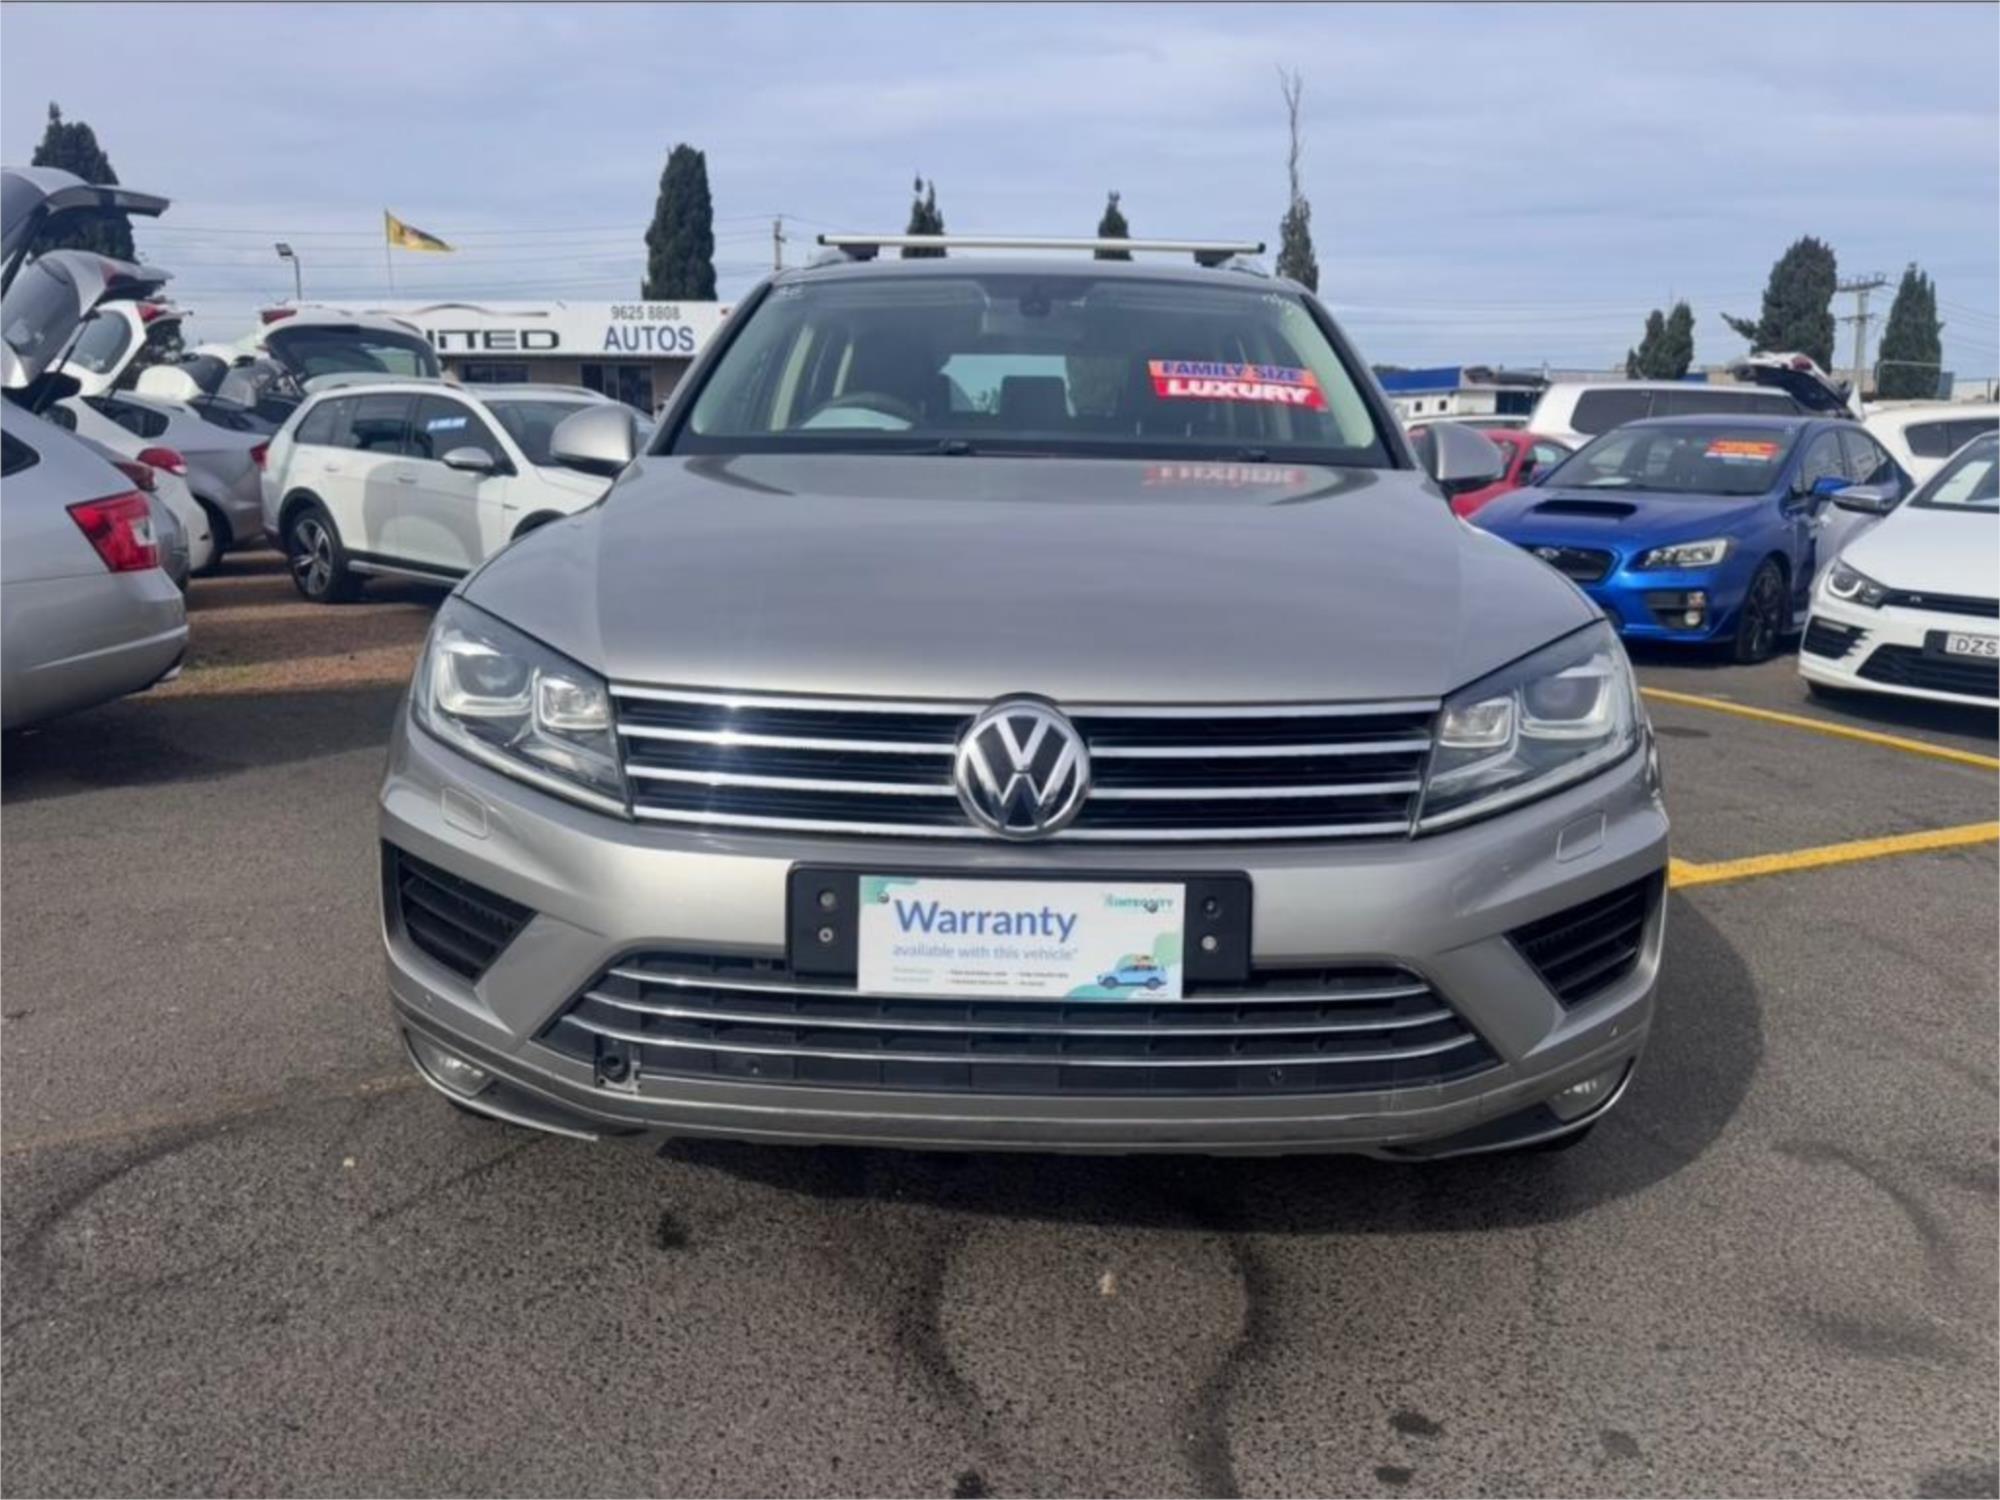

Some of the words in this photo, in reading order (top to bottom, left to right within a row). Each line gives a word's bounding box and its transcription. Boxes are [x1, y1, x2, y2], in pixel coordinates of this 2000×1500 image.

[611, 305, 644, 320] 9625
[603, 325, 694, 351] AUTOS
[1162, 361, 1244, 378] FAMILY
[1251, 366, 1301, 382] SIZE
[1167, 379, 1313, 404] LUXURY
[1956, 638, 1997, 655] DZS
[962, 706, 1082, 830] VW
[893, 899, 1077, 943] Warranty
[892, 943, 954, 958] available
[957, 944, 989, 959] with
[993, 945, 1021, 960] this
